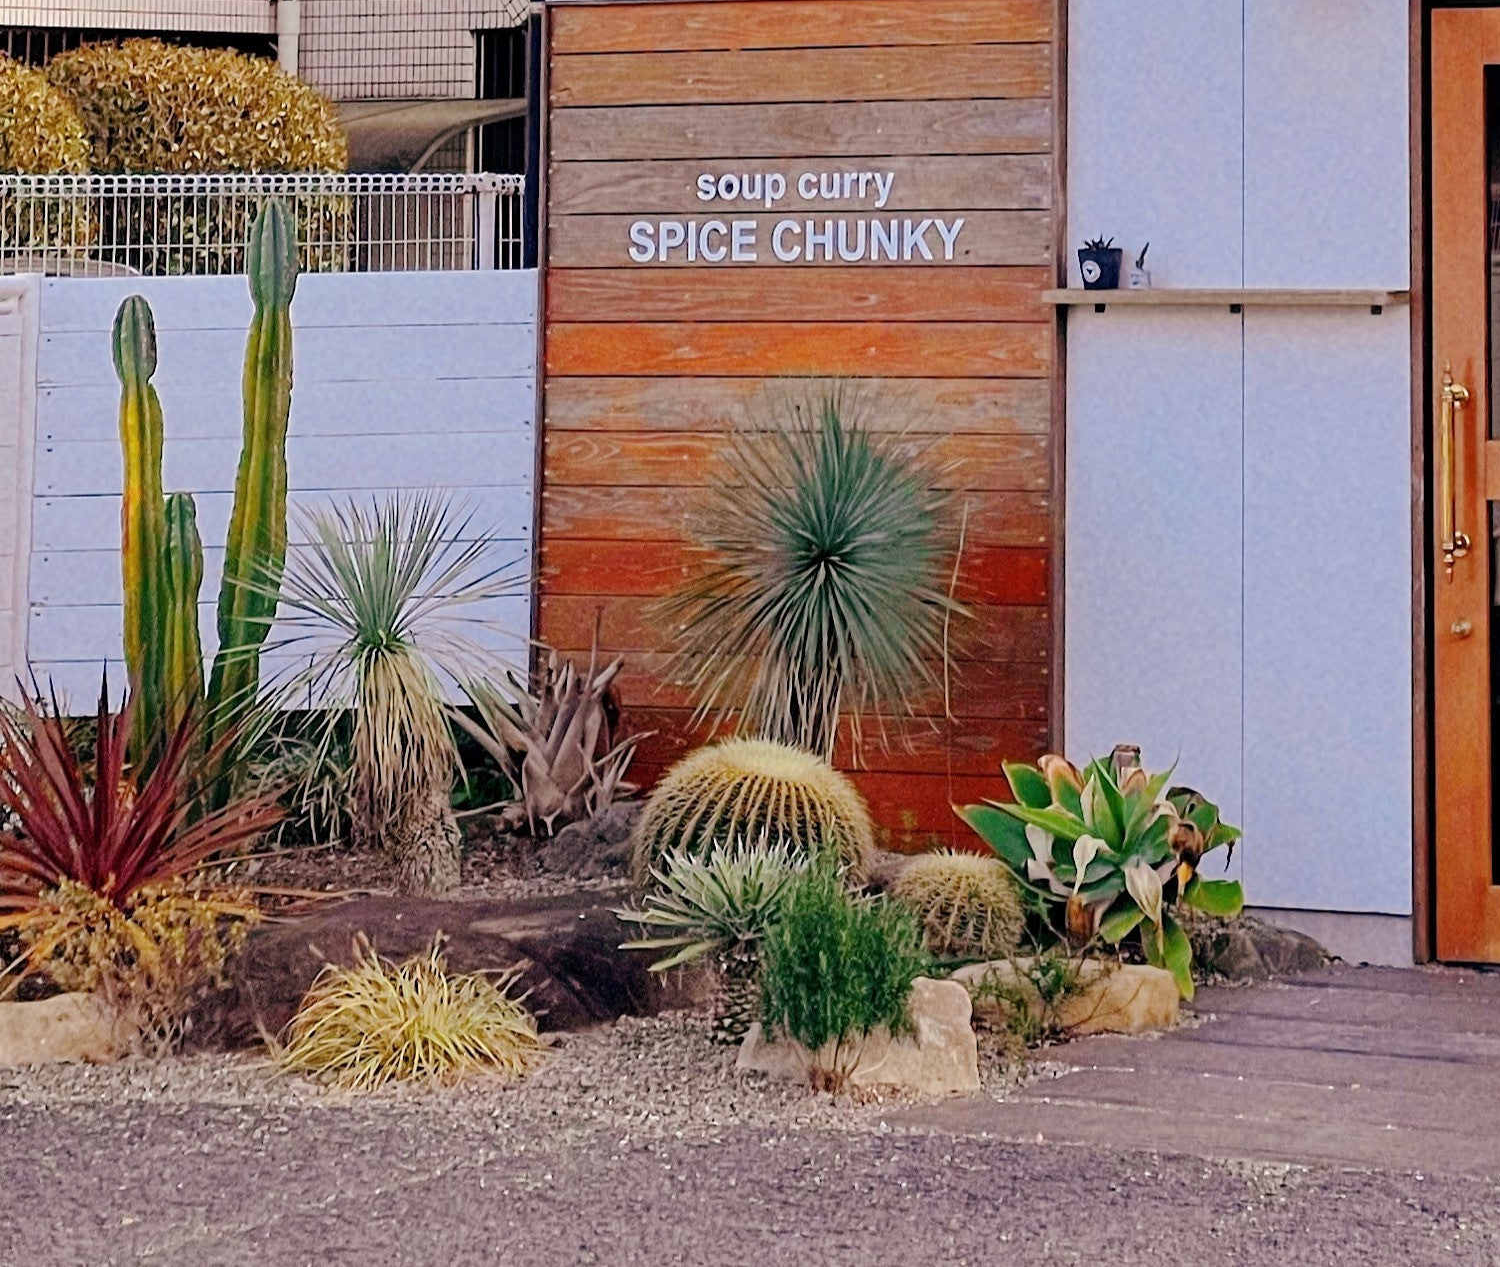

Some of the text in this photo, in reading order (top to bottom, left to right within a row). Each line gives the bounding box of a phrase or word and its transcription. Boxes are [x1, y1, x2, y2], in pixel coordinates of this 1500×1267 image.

[696, 171, 895, 207] soup curry
[629, 218, 965, 263] SPICE CHUNKY
